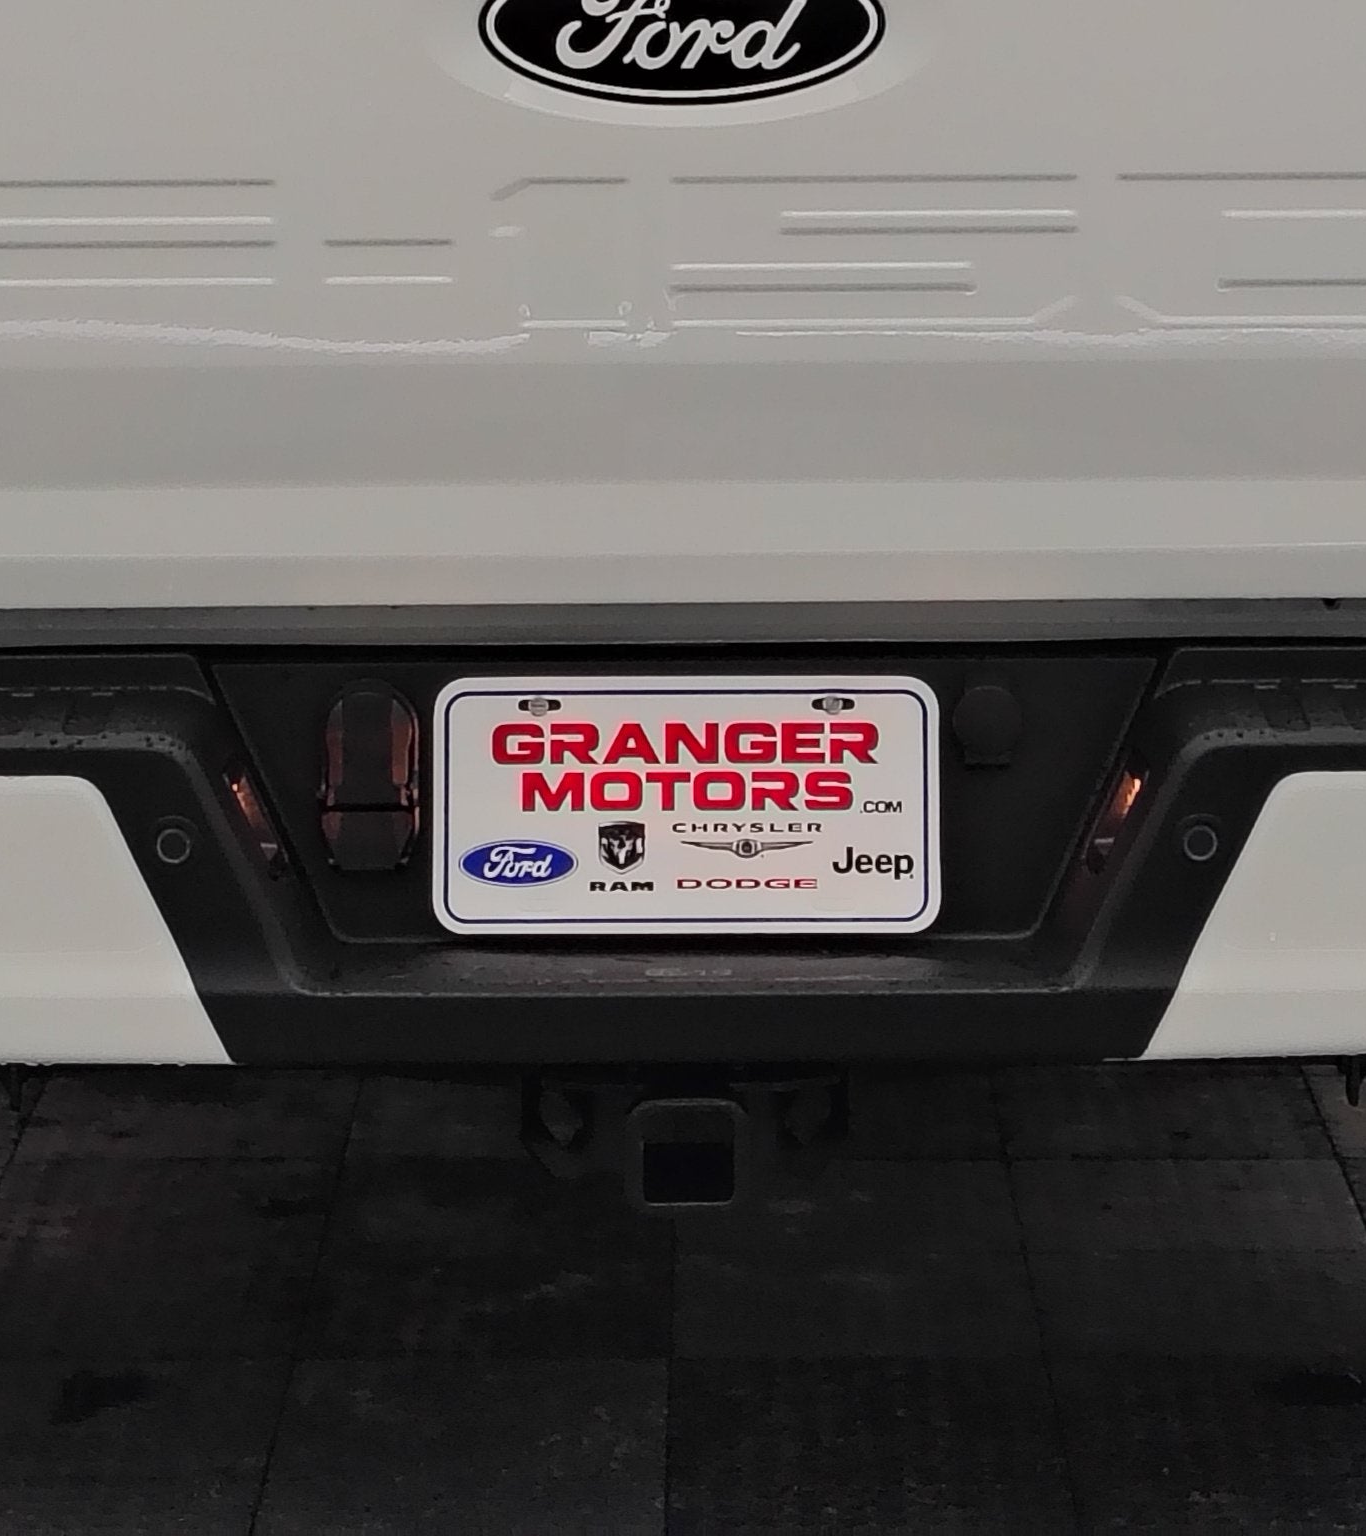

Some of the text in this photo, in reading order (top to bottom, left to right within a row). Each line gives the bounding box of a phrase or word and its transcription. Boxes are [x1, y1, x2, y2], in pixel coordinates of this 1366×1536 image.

[491, 721, 879, 765] GRANGER
[521, 770, 903, 814] MOTORS .COM
[671, 821, 823, 834] CHRYSLER
[483, 846, 553, 879] Ford
[832, 846, 916, 880] Jeep
[588, 881, 655, 893] RAM
[676, 878, 818, 890] DODGE
